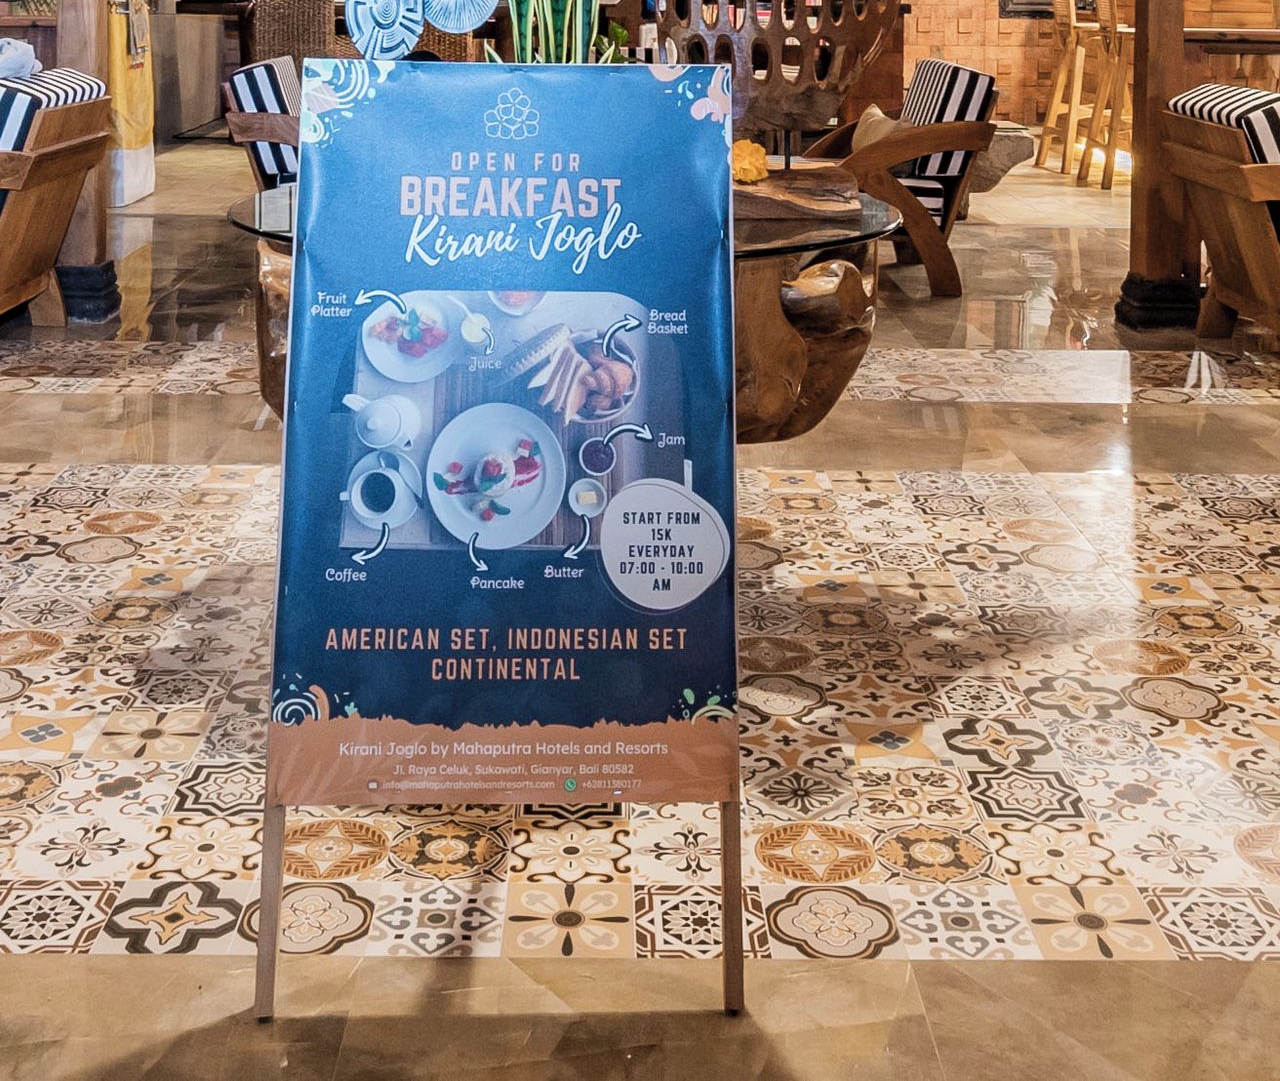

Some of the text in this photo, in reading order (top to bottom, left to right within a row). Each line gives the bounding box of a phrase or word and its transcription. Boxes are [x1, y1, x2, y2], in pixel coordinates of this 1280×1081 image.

[450, 151, 580, 171] OPEN FOR
[400, 175, 622, 217] BREAKFAST
[405, 203, 642, 274] Kirani Joglo
[317, 292, 347, 305] Fruit
[310, 306, 352, 317] Platter
[649, 309, 687, 321] Bread
[647, 322, 688, 334] Basket
[468, 356, 502, 371] Juice
[657, 433, 686, 448] Jam
[623, 512, 701, 525] START FROM
[651, 528, 672, 541] 15K
[628, 545, 694, 558] EVERYDAY
[325, 568, 368, 583] Coffee
[544, 565, 585, 579] Butter
[620, 562, 655, 575] 07:00
[670, 562, 704, 575] 10:00
[470, 576, 525, 590] Pancake
[652, 579, 671, 591] AM
[325, 628, 688, 652] AMERICAN SET, INDONESIAN SET
[431, 657, 581, 681] CONTINENTAL
[339, 741, 669, 758] Kirani Joglo by Mahaputra Hotels and Resorts
[393, 764, 634, 777] Jl. Raya Celuk, Sukawati, Gianyar, Bali 80582
